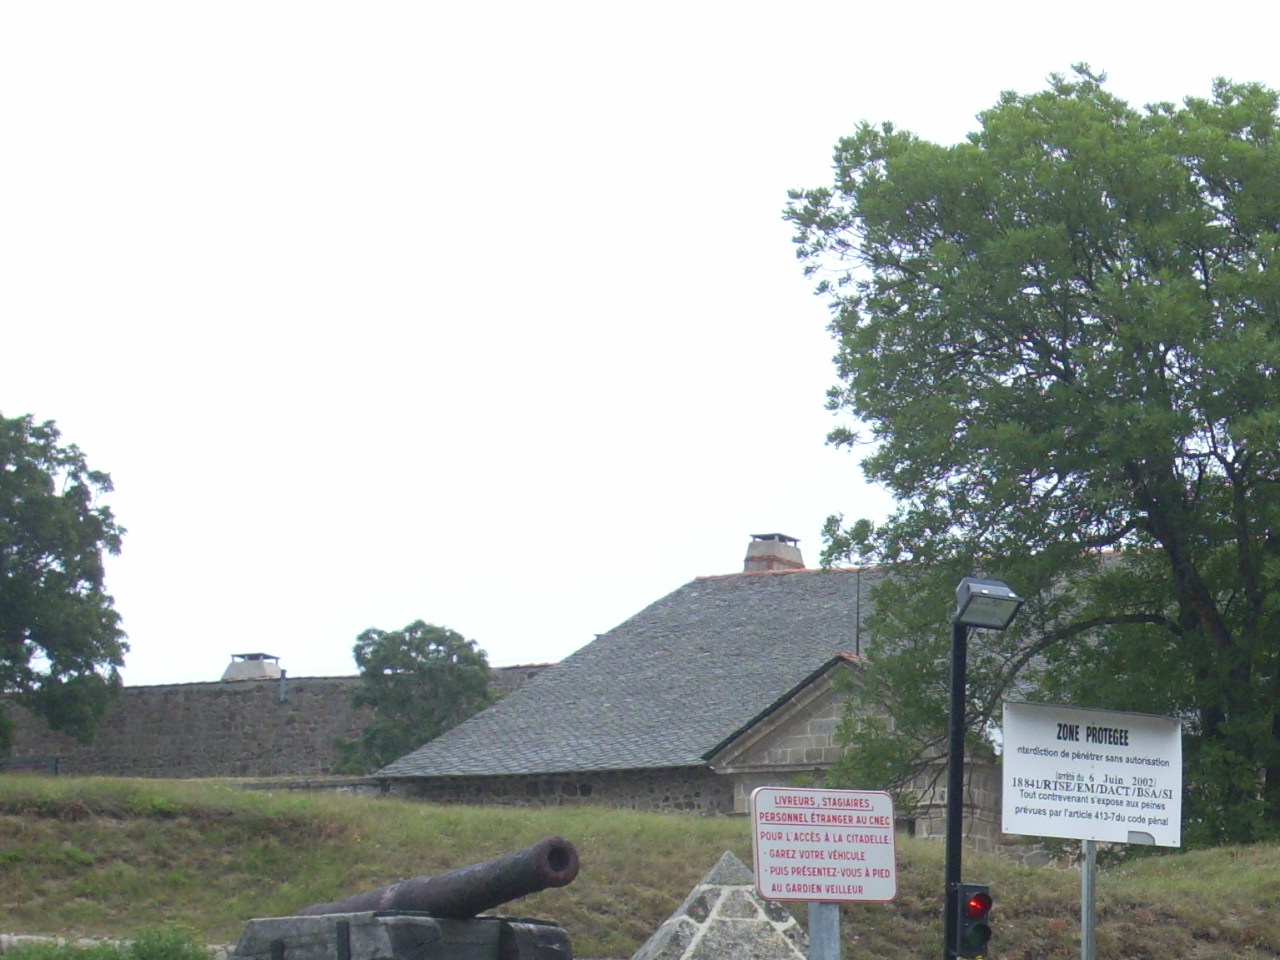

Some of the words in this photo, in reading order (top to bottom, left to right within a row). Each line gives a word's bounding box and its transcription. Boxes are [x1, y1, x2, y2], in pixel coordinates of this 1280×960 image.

[1057, 723, 1079, 741] ZONE
[1086, 726, 1129, 746] PROTEGEE
[1016, 746, 1059, 757] nterdiction
[1061, 749, 1070, 758] de
[1072, 750, 1103, 762] pénétrer
[1105, 754, 1123, 763] sans
[1125, 756, 1169, 767] autorisation
[1089, 774, 1094, 782] 6
[1103, 774, 1124, 785] Juin
[1020, 790, 1036, 799] Tout
[1038, 792, 1088, 804] contrevenant
[1091, 795, 1124, 807] s'expose
[1126, 799, 1139, 808] aux
[1141, 800, 1165, 810] peines
[760, 812, 808, 822] PERSONNEL
[811, 812, 853, 824] ÉTRANGER
[856, 815, 866, 824] AU
[869, 816, 890, 825] CNEC
[1015, 806, 1047, 815] prévues
[1049, 808, 1061, 817] par
[1128, 815, 1145, 824] code
[1148, 817, 1168, 826] pénal
[761, 832, 783, 840] POUR
[825, 832, 829, 842] À
[833, 834, 843, 843] LA
[769, 850, 796, 858] GAREZ
[799, 850, 824, 859] VOTRE
[828, 849, 866, 861] VÉHICULE
[770, 866, 788, 876] PUIS
[791, 865, 862, 877] PRÉSENTEZ-VOUS
[865, 867, 870, 877] À
[873, 869, 890, 878] PIED
[771, 884, 782, 892] AU
[786, 884, 821, 893] GARDIEN
[825, 885, 863, 894] VEILLEUR
